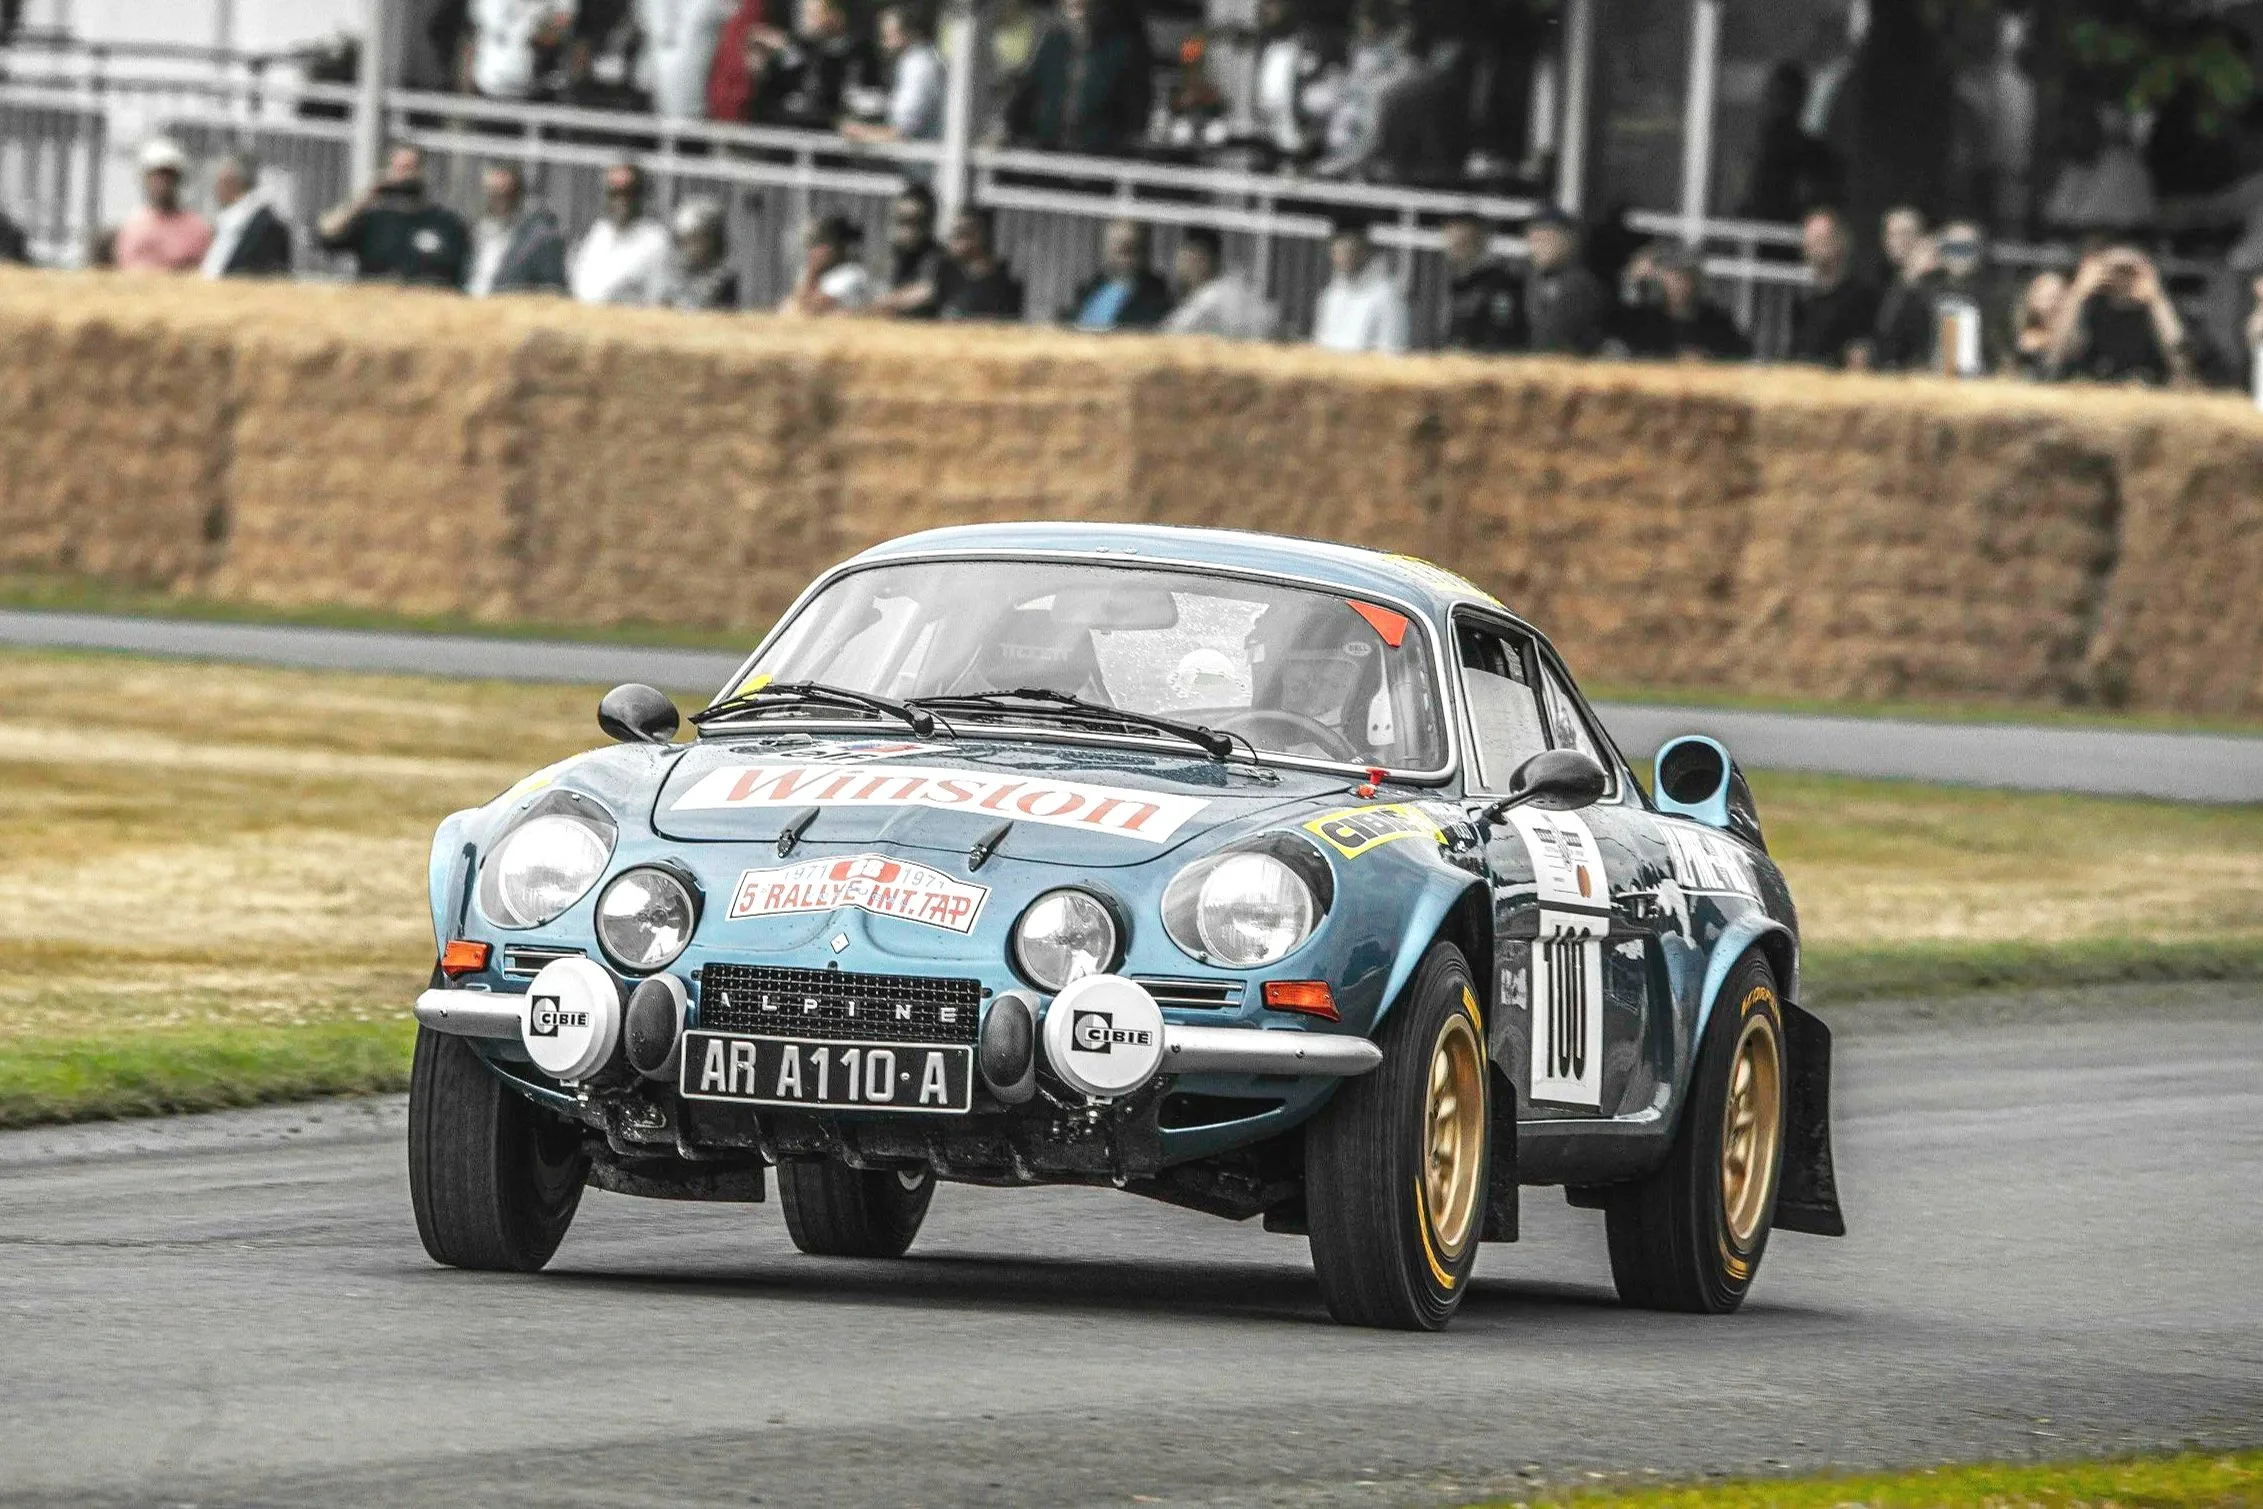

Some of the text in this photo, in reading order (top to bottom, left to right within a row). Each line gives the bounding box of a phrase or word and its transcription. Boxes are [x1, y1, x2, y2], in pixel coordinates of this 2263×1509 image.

[726, 768, 1161, 832] Winston
[739, 883, 759, 913] 5
[764, 880, 863, 910] RALLYE
[719, 991, 957, 1023] ALPINE
[1543, 924, 1592, 1081] 100
[700, 1039, 949, 1105] AR A110 A
